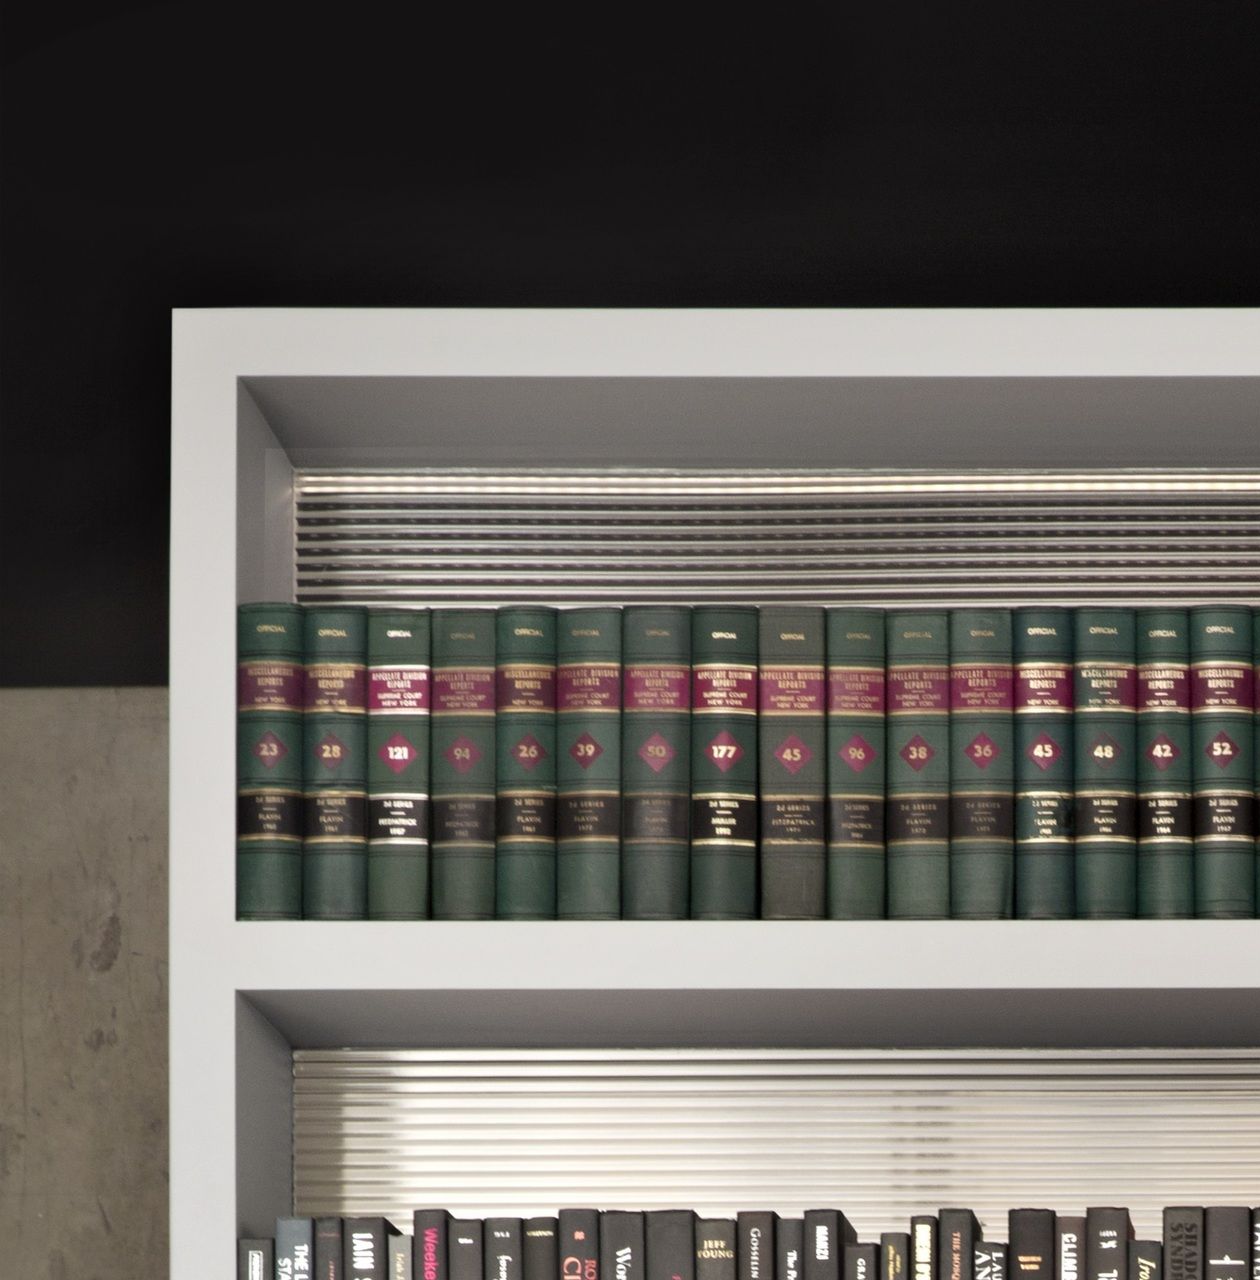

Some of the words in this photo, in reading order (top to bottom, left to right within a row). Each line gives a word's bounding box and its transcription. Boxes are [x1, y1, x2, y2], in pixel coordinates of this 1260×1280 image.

[1027, 627, 1056, 636] OFFICIAL
[260, 744, 278, 756] 23
[322, 745, 340, 757] 28
[387, 747, 408, 759] 121
[519, 744, 537, 758] 26
[577, 744, 595, 757] 39
[712, 745, 736, 759] 177
[782, 748, 801, 761] 45
[909, 746, 927, 759] 38
[974, 745, 992, 757] 36
[1033, 745, 1053, 757] 45
[1094, 746, 1113, 758] 48
[1213, 743, 1232, 756] 52
[294, 1244, 309, 1270] THE
[352, 1233, 374, 1269] IAIN
[1063, 1233, 1077, 1280] CLIMB
